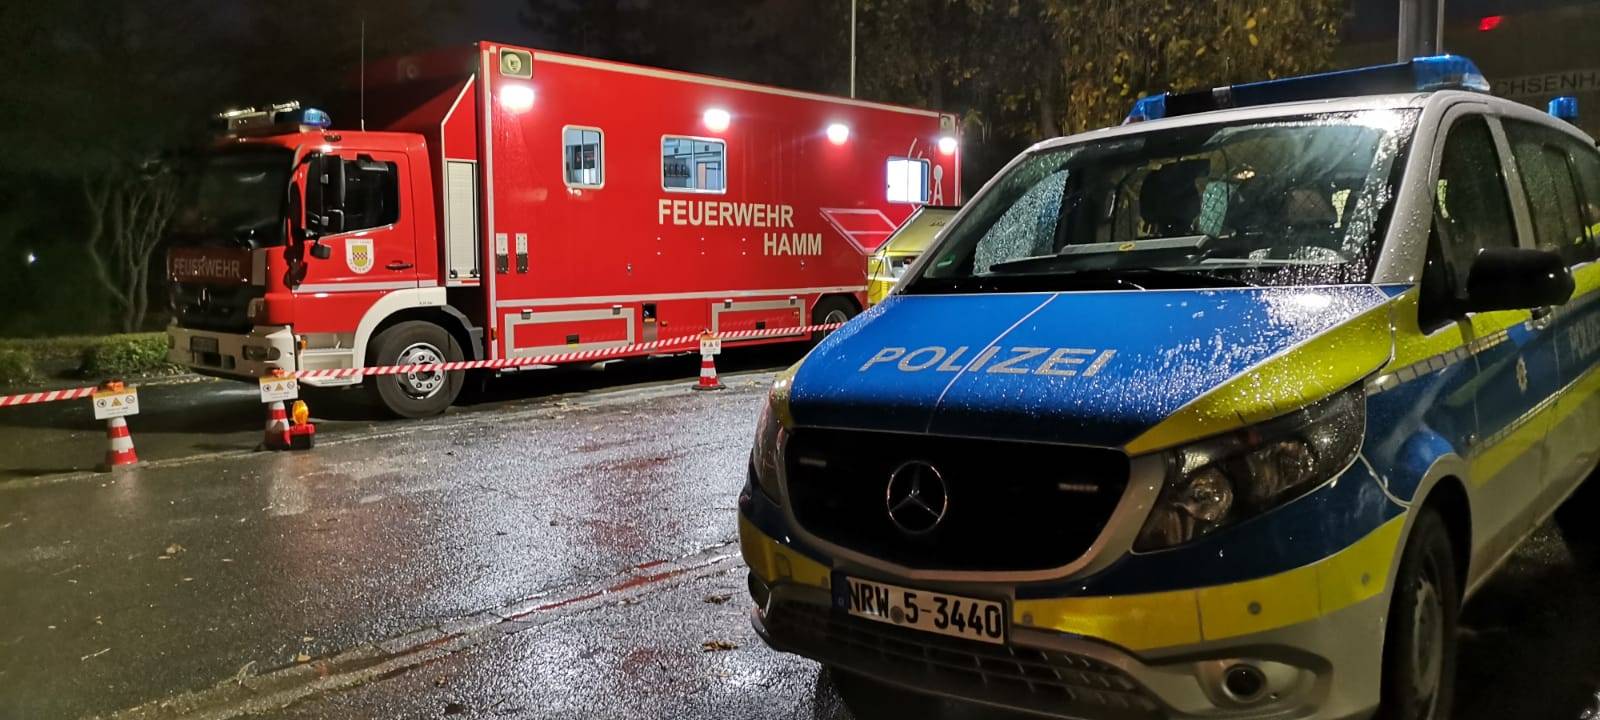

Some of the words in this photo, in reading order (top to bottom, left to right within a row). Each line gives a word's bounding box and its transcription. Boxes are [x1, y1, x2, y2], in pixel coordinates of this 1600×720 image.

[1495, 72, 1600, 96] CHSENH
[658, 199, 794, 228] FEUERWEHR
[763, 232, 822, 256] HAMM
[174, 258, 241, 278] FEUERWEHR
[858, 346, 1117, 377] POLIZEI
